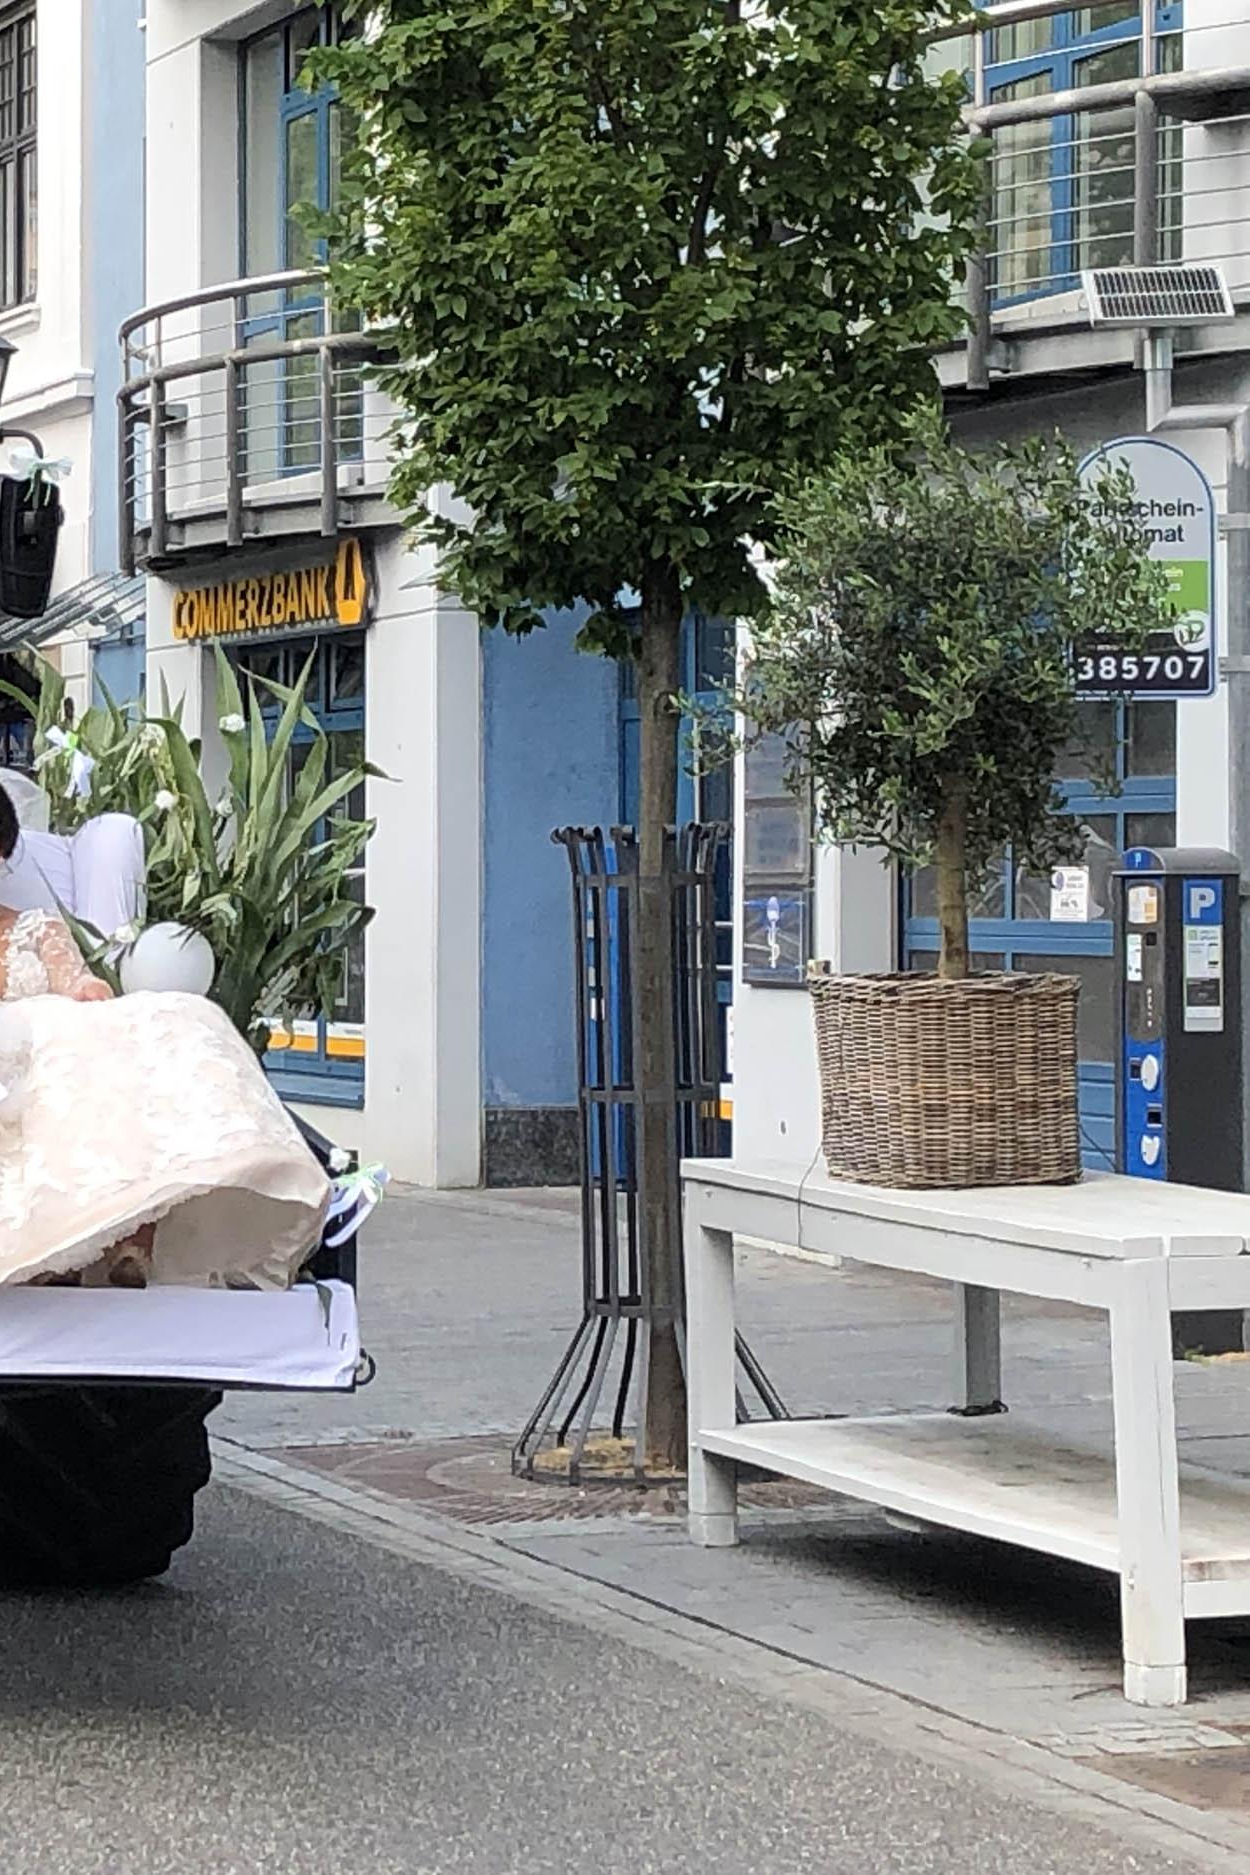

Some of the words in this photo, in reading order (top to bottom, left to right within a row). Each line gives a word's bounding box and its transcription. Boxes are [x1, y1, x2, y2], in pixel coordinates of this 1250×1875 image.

[172, 564, 331, 640] COMMERZBANK
[1077, 655, 1205, 681] 385707
[1189, 887, 1215, 918] P
